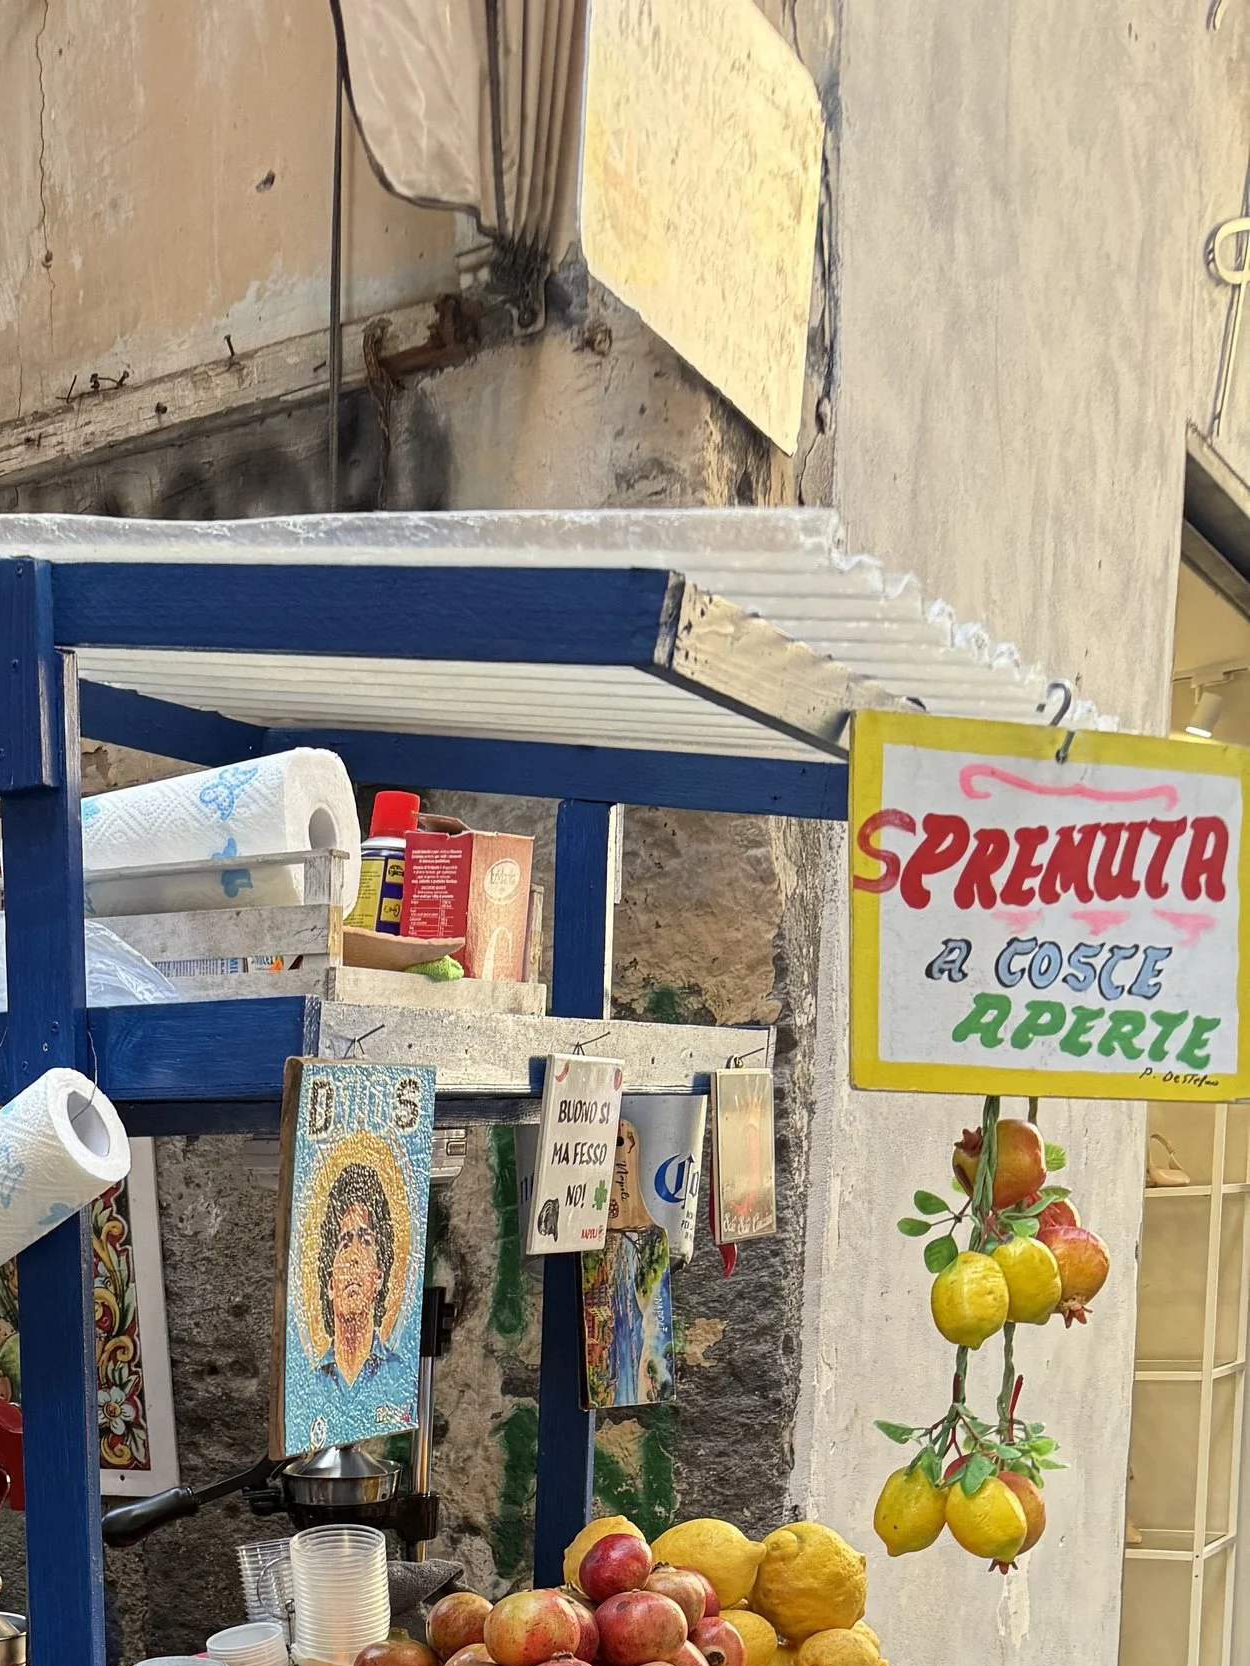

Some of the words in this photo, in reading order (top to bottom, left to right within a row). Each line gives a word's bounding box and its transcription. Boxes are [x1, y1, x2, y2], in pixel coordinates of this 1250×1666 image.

[853, 808, 1230, 910] SPREMUTA
[925, 938, 972, 983] A
[994, 937, 1173, 1001] COSCE
[952, 992, 1221, 1070] APERTE
[558, 1099, 599, 1124] BUONO
[600, 1101, 610, 1125] SI
[551, 1141, 570, 1166] MA
[572, 1141, 608, 1166] FESSO
[565, 1182, 587, 1209] NO!
